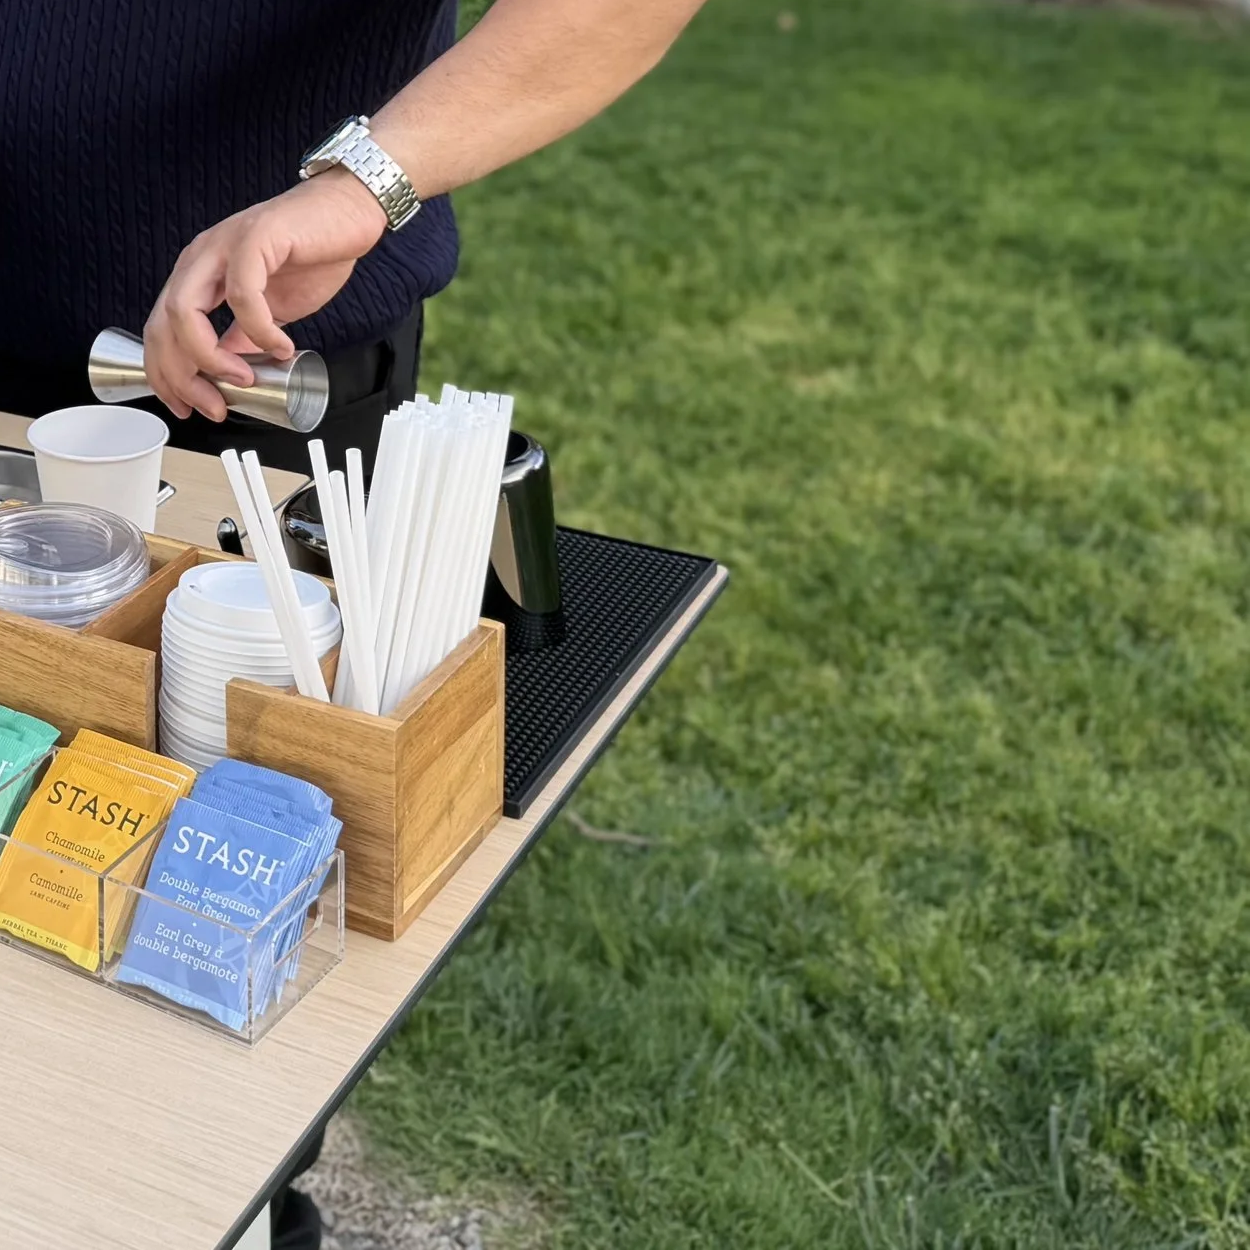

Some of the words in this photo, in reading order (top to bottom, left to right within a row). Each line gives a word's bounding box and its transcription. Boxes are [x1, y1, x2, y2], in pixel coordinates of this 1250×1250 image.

[47, 780, 145, 837] STASH
[46, 830, 106, 863] Chamomile
[172, 826, 280, 886] STASH
[29, 872, 84, 902] Camomille
[159, 871, 200, 896] Double
[201, 887, 262, 920] Bergamot
[175, 894, 200, 912] Earl
[26, 927, 39, 937] TEA
[155, 922, 181, 943] Earl
[182, 933, 212, 957] Grey
[133, 932, 170, 956] double
[172, 946, 239, 984] bergamote
